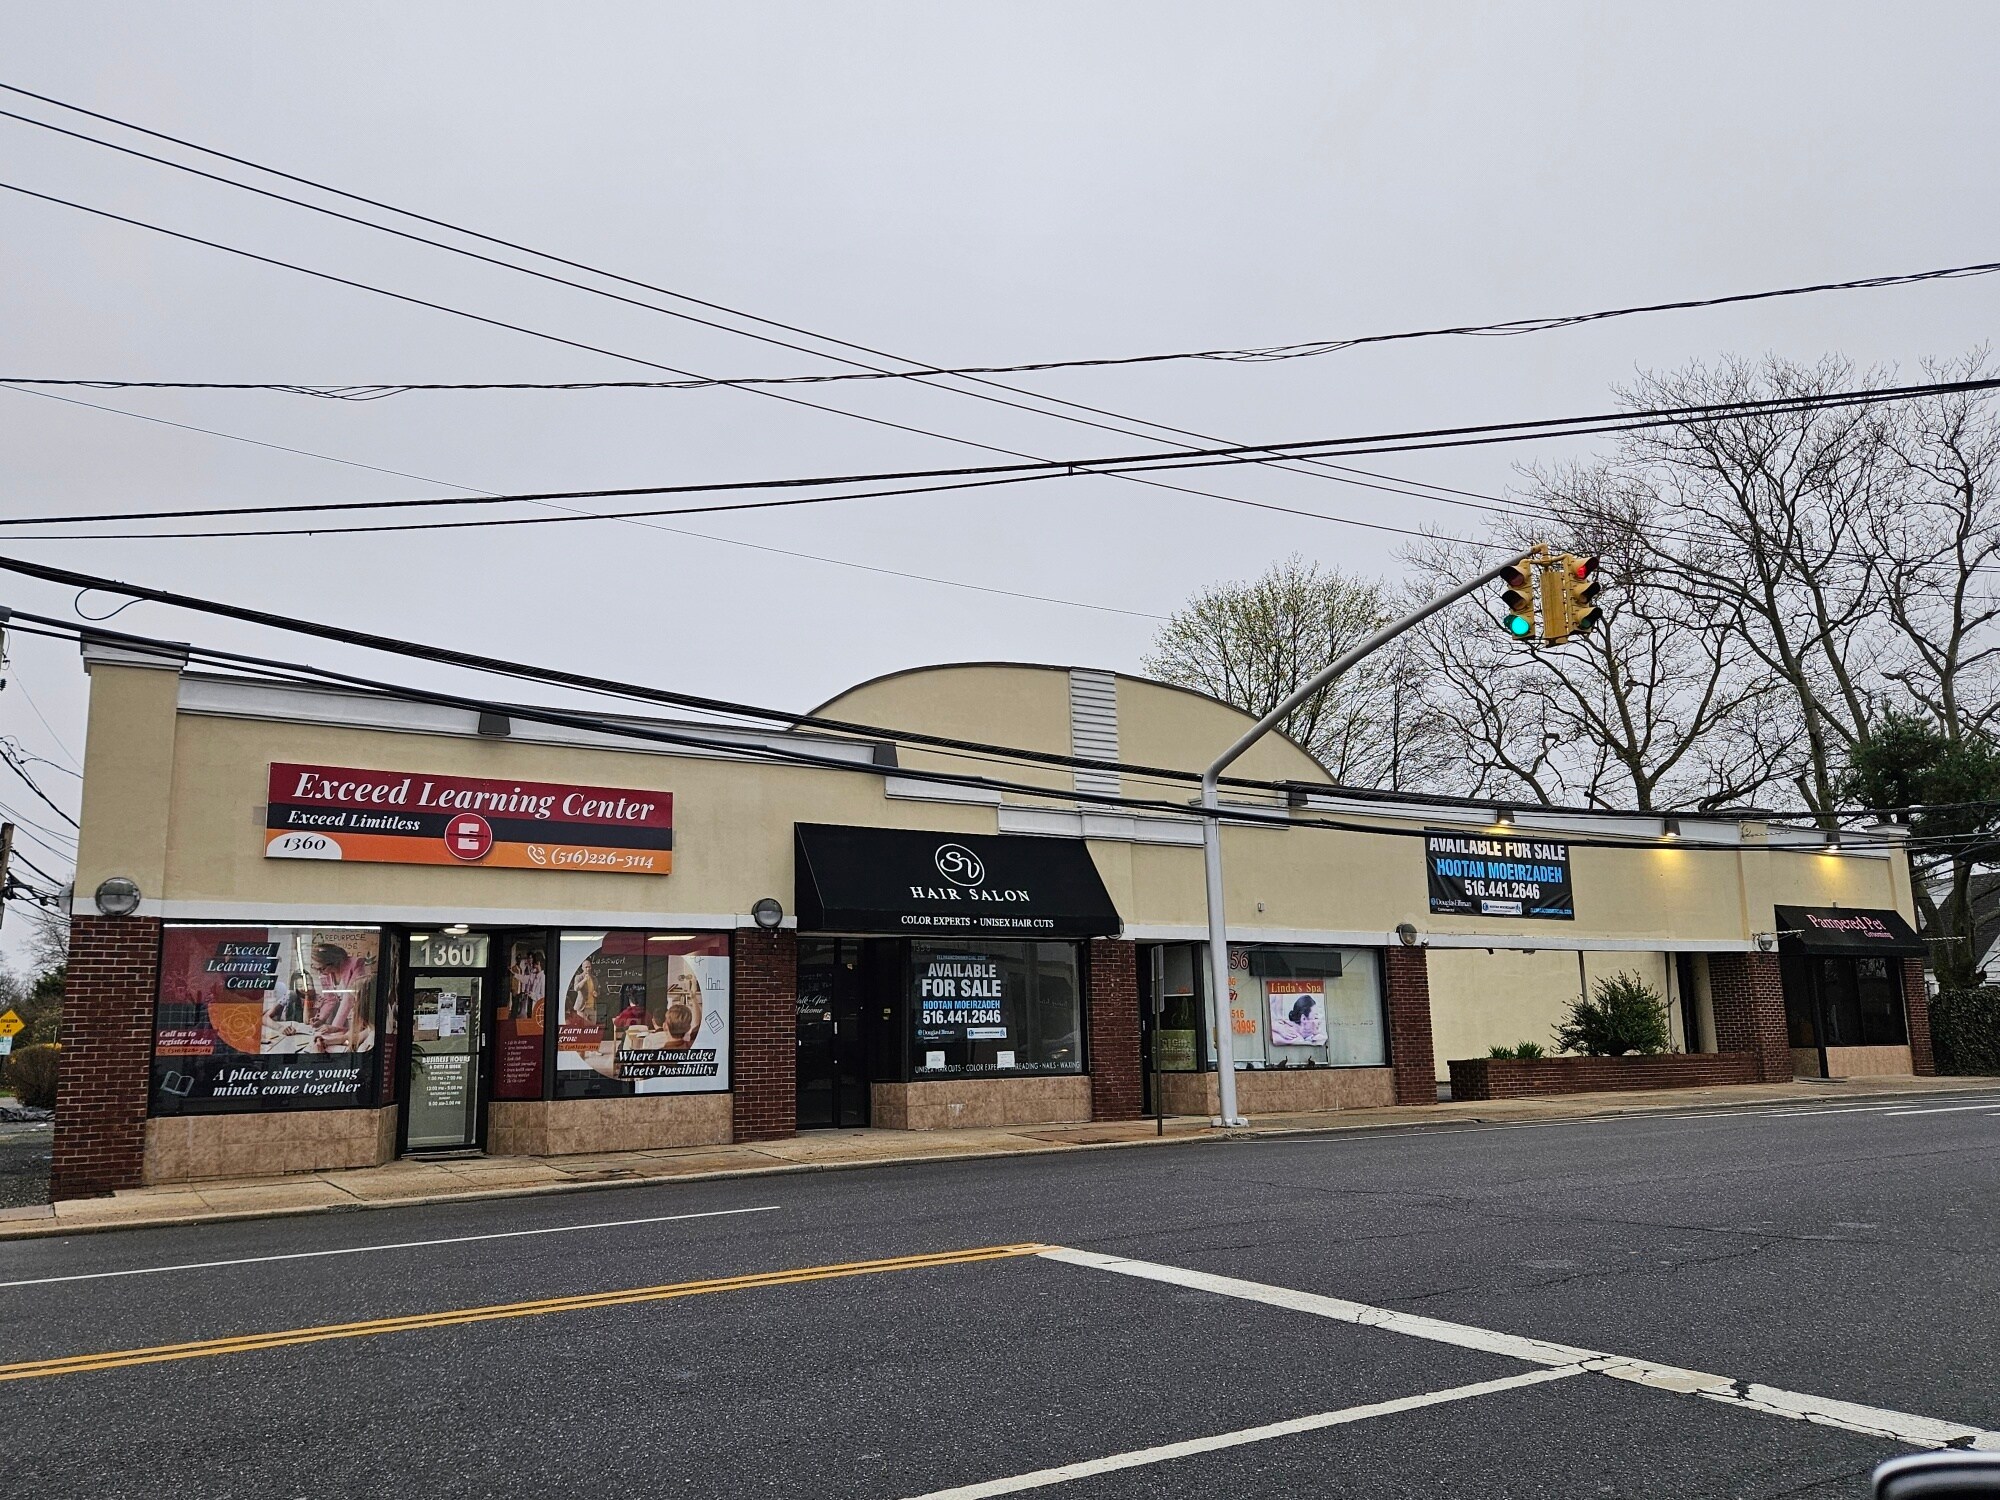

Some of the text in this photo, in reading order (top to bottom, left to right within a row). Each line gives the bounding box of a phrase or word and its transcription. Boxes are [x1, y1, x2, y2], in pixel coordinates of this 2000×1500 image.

[291, 771, 655, 822] Exceed Learning Center
[287, 810, 421, 831] Exceed Limitless
[283, 836, 326, 851] 1360
[1429, 837, 1566, 862] AVAILABLE FOR SALE
[551, 848, 655, 869] (516)226-3114
[1436, 858, 1563, 884] HOOTAN MOEIRZADEH
[909, 885, 1031, 903] HAIR SALON
[1464, 879, 1540, 900] 516.441.2646
[901, 915, 1054, 929] COLOR EXPERTS UNISEX HAIR CUTS
[1806, 914, 1887, 933] Pampered Pet
[223, 943, 271, 956] Exceed
[420, 941, 475, 966] 1360
[206, 960, 271, 975] Learning
[1230, 950, 1249, 970] 56
[927, 962, 997, 978] AVAILABLE
[226, 976, 274, 990] Center
[921, 978, 1002, 998] FOR SALE
[1271, 982, 1322, 994] Linda's Spa
[922, 1000, 1001, 1010] HOOTAN MOEIRZADEH
[922, 1009, 1001, 1024] 516.441.2646
[159, 1030, 177, 1038] Call
[558, 1026, 600, 1035] Learn and
[1233, 1020, 1256, 1034] -3995
[158, 1038, 211, 1046] register today
[558, 1035, 578, 1044] grow
[422, 1055, 471, 1064] BUSINESS HOURS
[618, 1050, 714, 1062] Where Knowledge
[621, 1064, 716, 1077] Meets Possibility.
[948, 1064, 962, 1073] CUTS
[965, 1063, 984, 1072] COLOR
[1041, 1062, 1057, 1070] NAILS
[1060, 1060, 1081, 1070] WAXING
[212, 1067, 360, 1083] A place where young
[212, 1081, 361, 1097] minds come together
